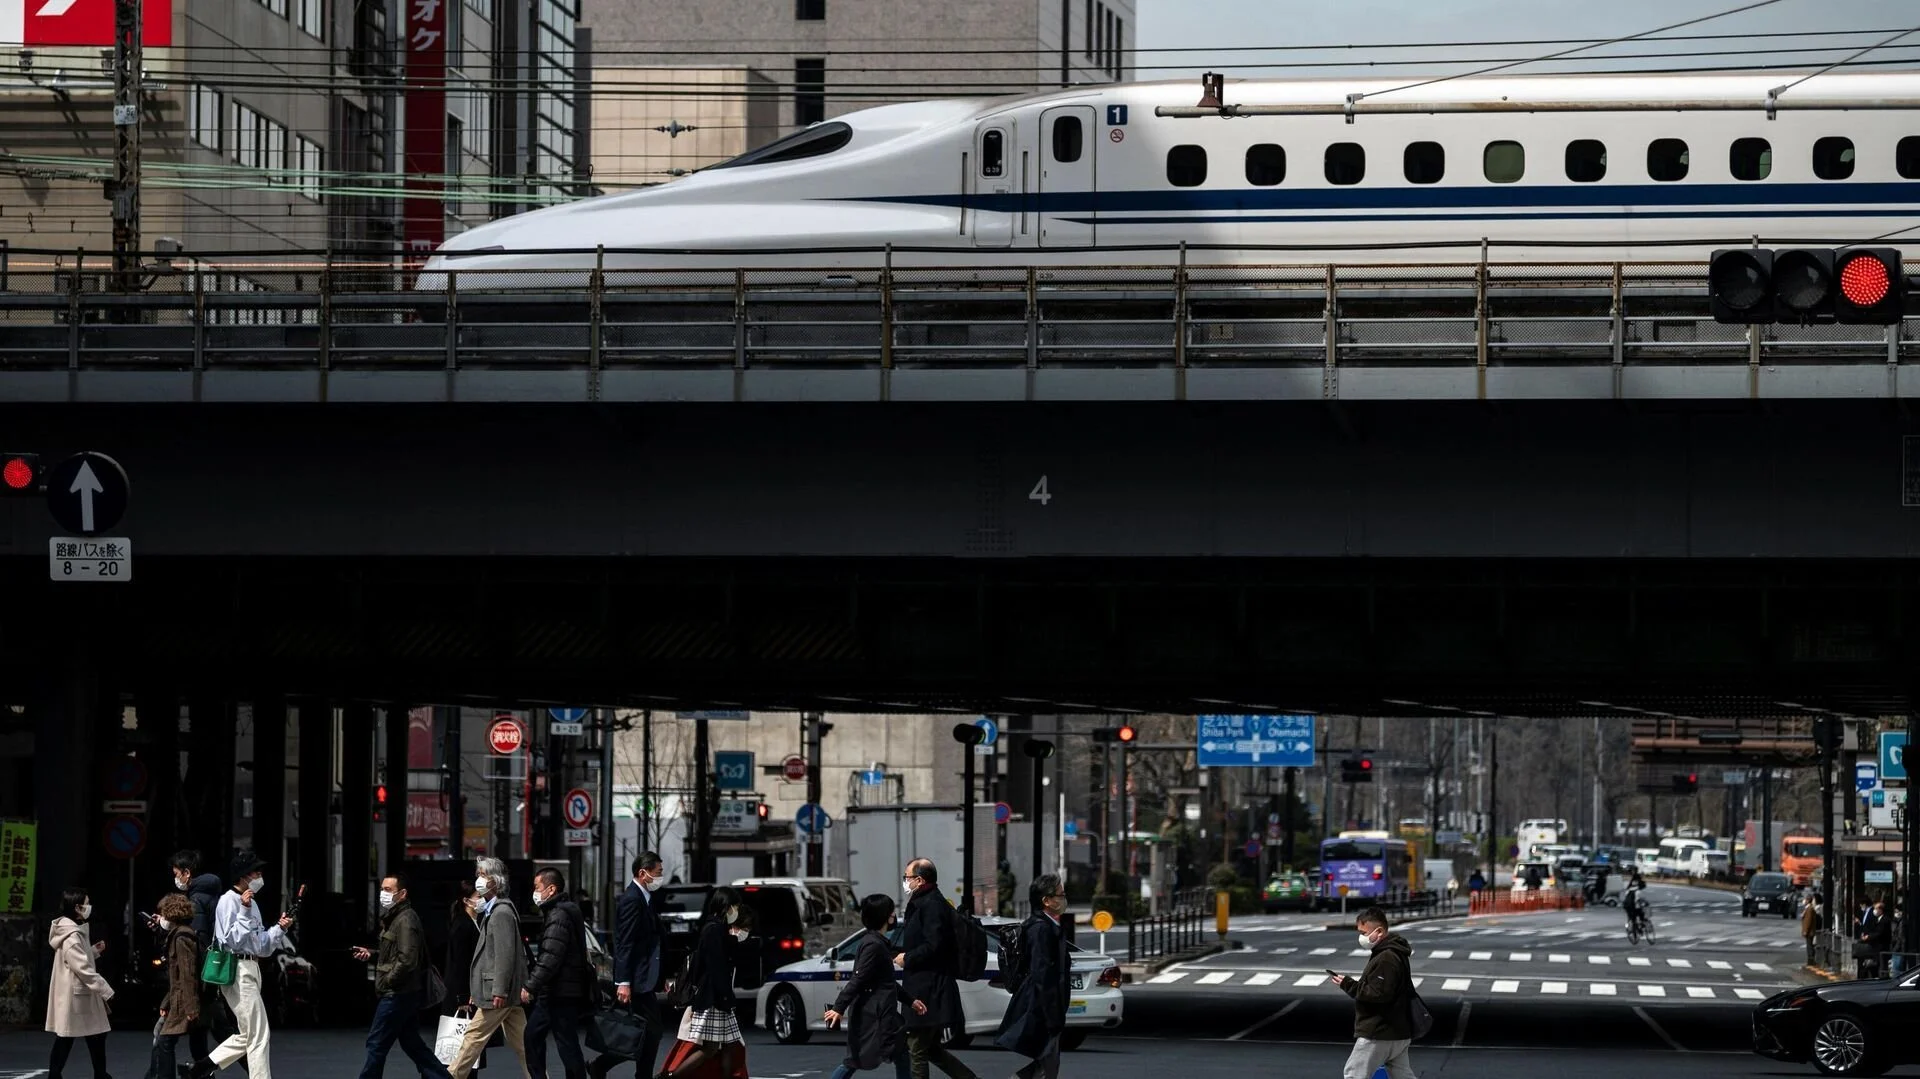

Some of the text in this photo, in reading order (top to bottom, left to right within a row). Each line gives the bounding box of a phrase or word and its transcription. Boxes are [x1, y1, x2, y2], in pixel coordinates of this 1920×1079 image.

[1112, 107, 1121, 124] 1
[1029, 475, 1052, 506] 4
[56, 542, 124, 558] 路線バスを除く
[63, 561, 73, 576] 8
[99, 561, 119, 576] 20
[494, 731, 519, 744] 消火栓
[1201, 728, 1310, 737] Shiba Park Otemachi
